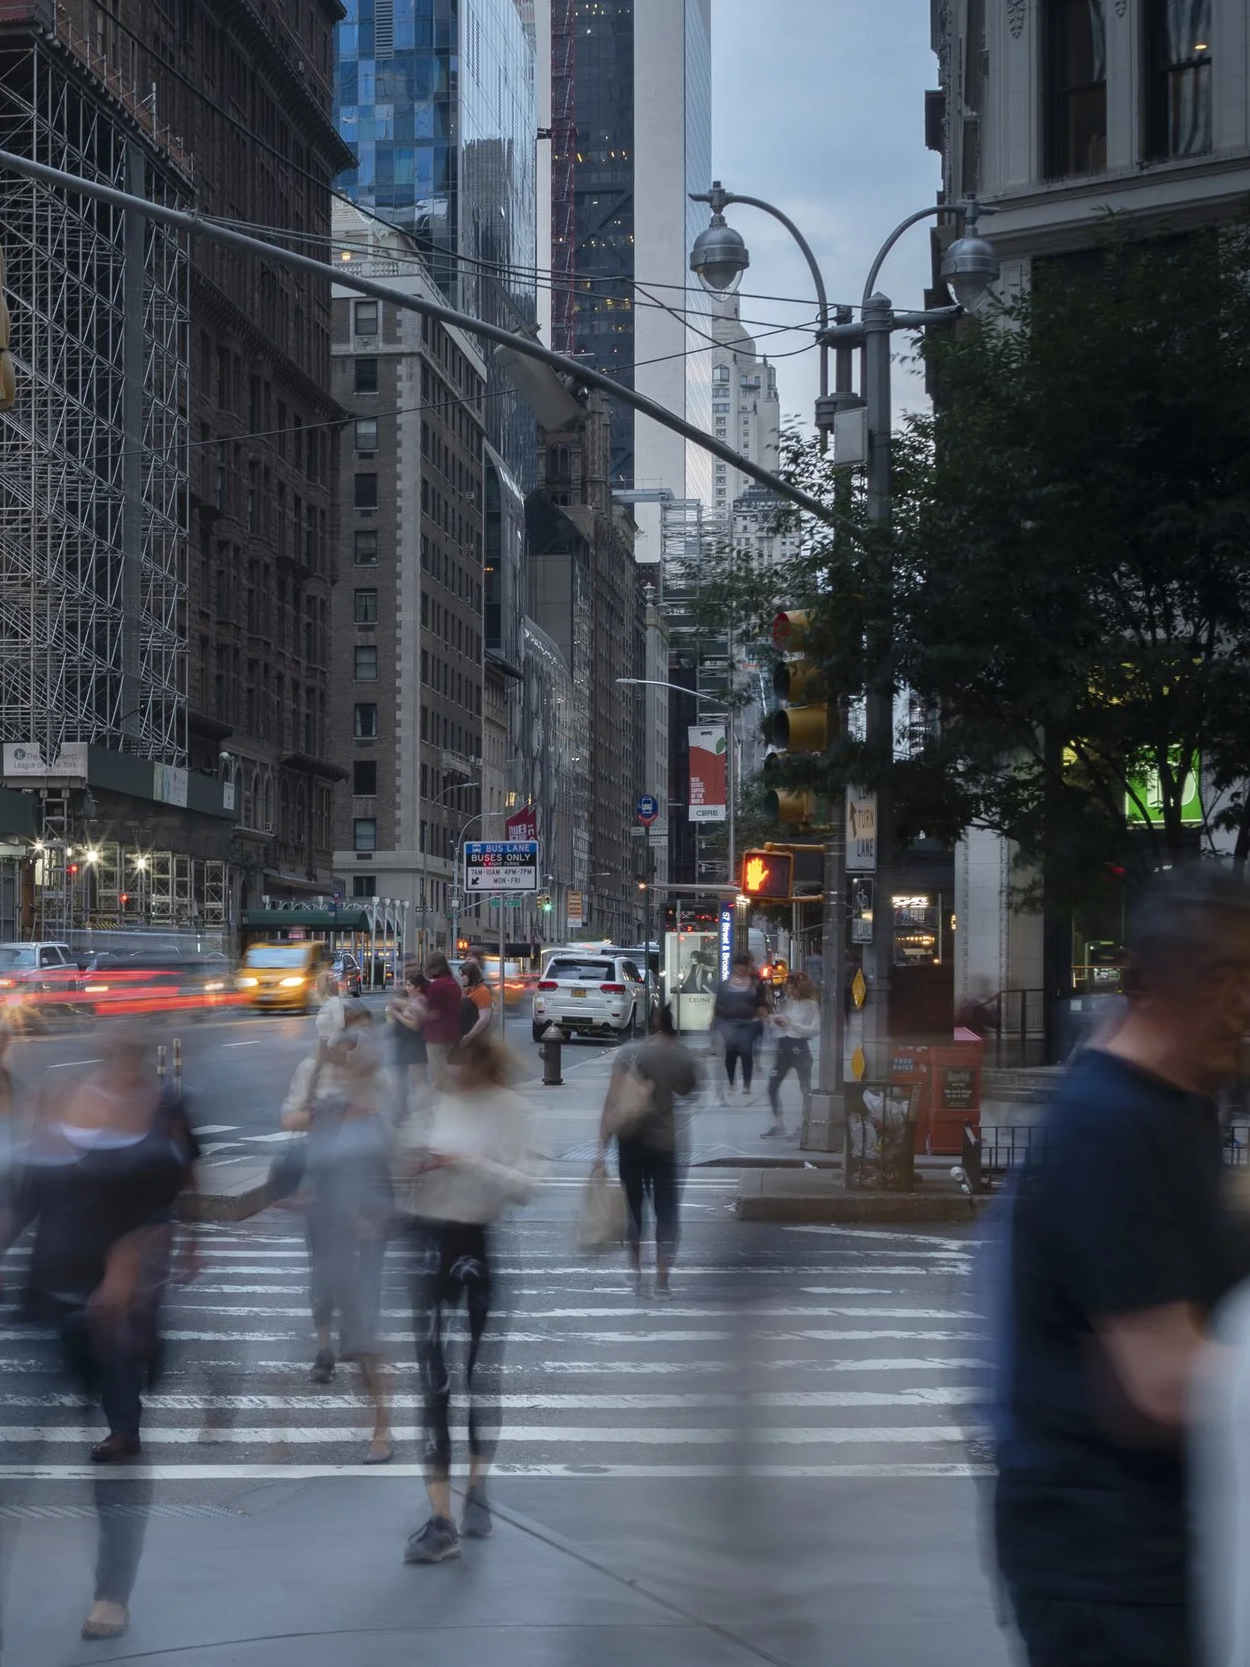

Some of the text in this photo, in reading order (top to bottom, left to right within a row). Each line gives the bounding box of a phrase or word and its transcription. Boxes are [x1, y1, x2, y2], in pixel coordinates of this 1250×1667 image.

[14, 761, 36, 770] League
[858, 809, 874, 829] TURN
[486, 844, 530, 852] BUS LANE
[857, 838, 874, 857] LANE
[471, 853, 530, 862] BUSES ONLY
[722, 911, 730, 921] 57
[722, 922, 730, 944] Street
[722, 952, 730, 982] Broadw
